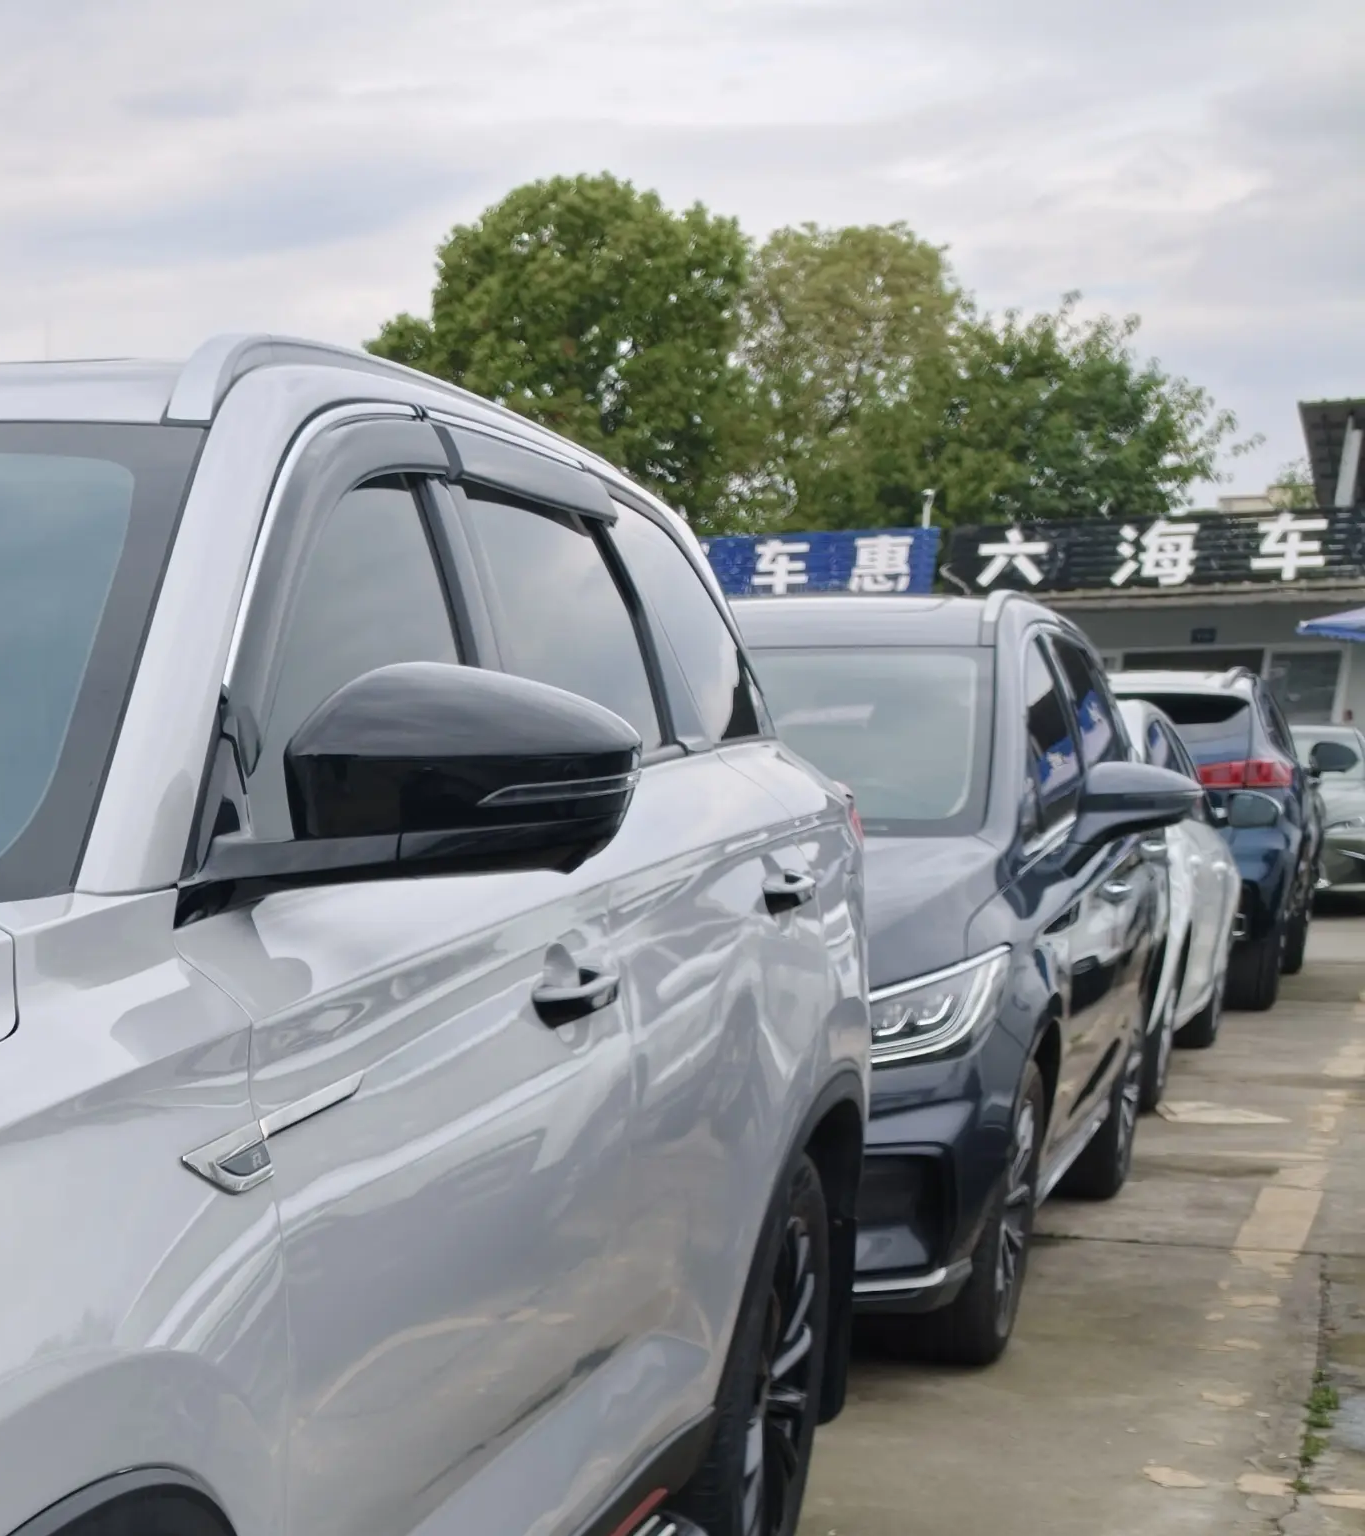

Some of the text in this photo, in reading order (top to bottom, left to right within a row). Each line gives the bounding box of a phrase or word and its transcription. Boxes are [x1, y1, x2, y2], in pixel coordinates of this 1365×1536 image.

[700, 535, 915, 595] 车惠
[975, 512, 1330, 587] 六海车
